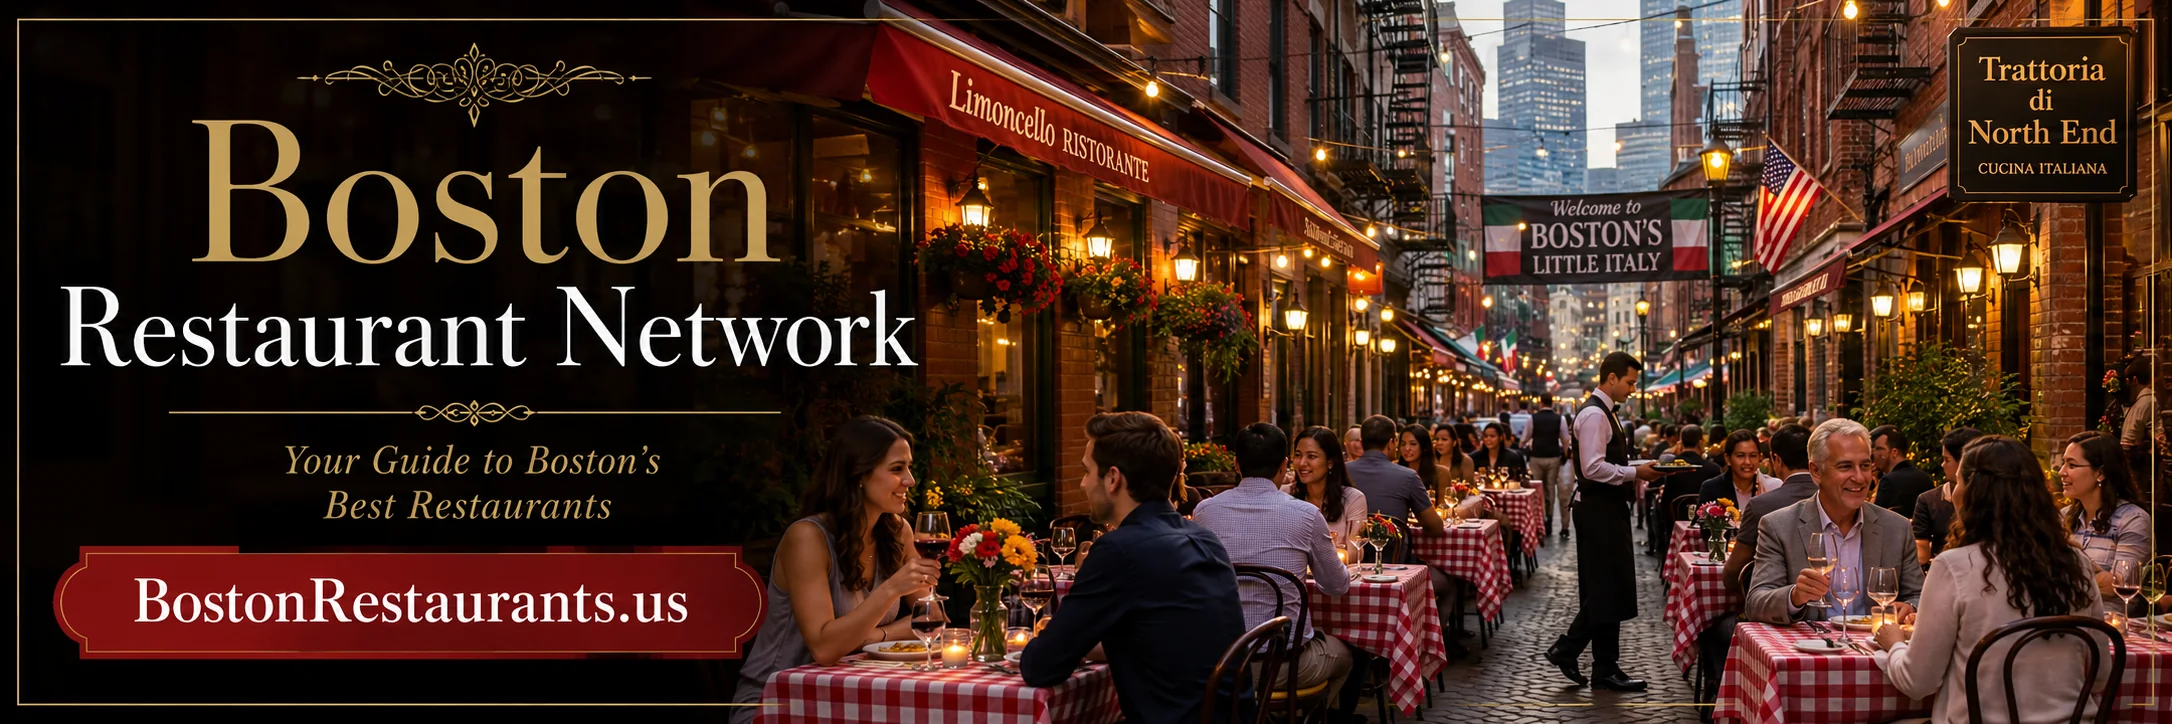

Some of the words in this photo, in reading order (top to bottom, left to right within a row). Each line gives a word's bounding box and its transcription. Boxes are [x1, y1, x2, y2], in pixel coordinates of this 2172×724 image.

[1978, 55, 2106, 81] Trattoria
[2029, 88, 2054, 111] di
[949, 70, 1055, 147] Limoncello
[1062, 128, 1150, 183] RISTORANTE
[1968, 119, 2051, 145] North
[2060, 118, 2118, 145] End
[1978, 162, 2035, 175] CUCINA
[2039, 162, 2108, 175] ITALIANA
[1550, 199, 1622, 217] Welcome
[1625, 199, 1642, 215] to
[1530, 218, 1663, 249] BOSTON’S
[1533, 254, 1599, 275] LITTLE
[1605, 252, 1661, 273] ITALY
